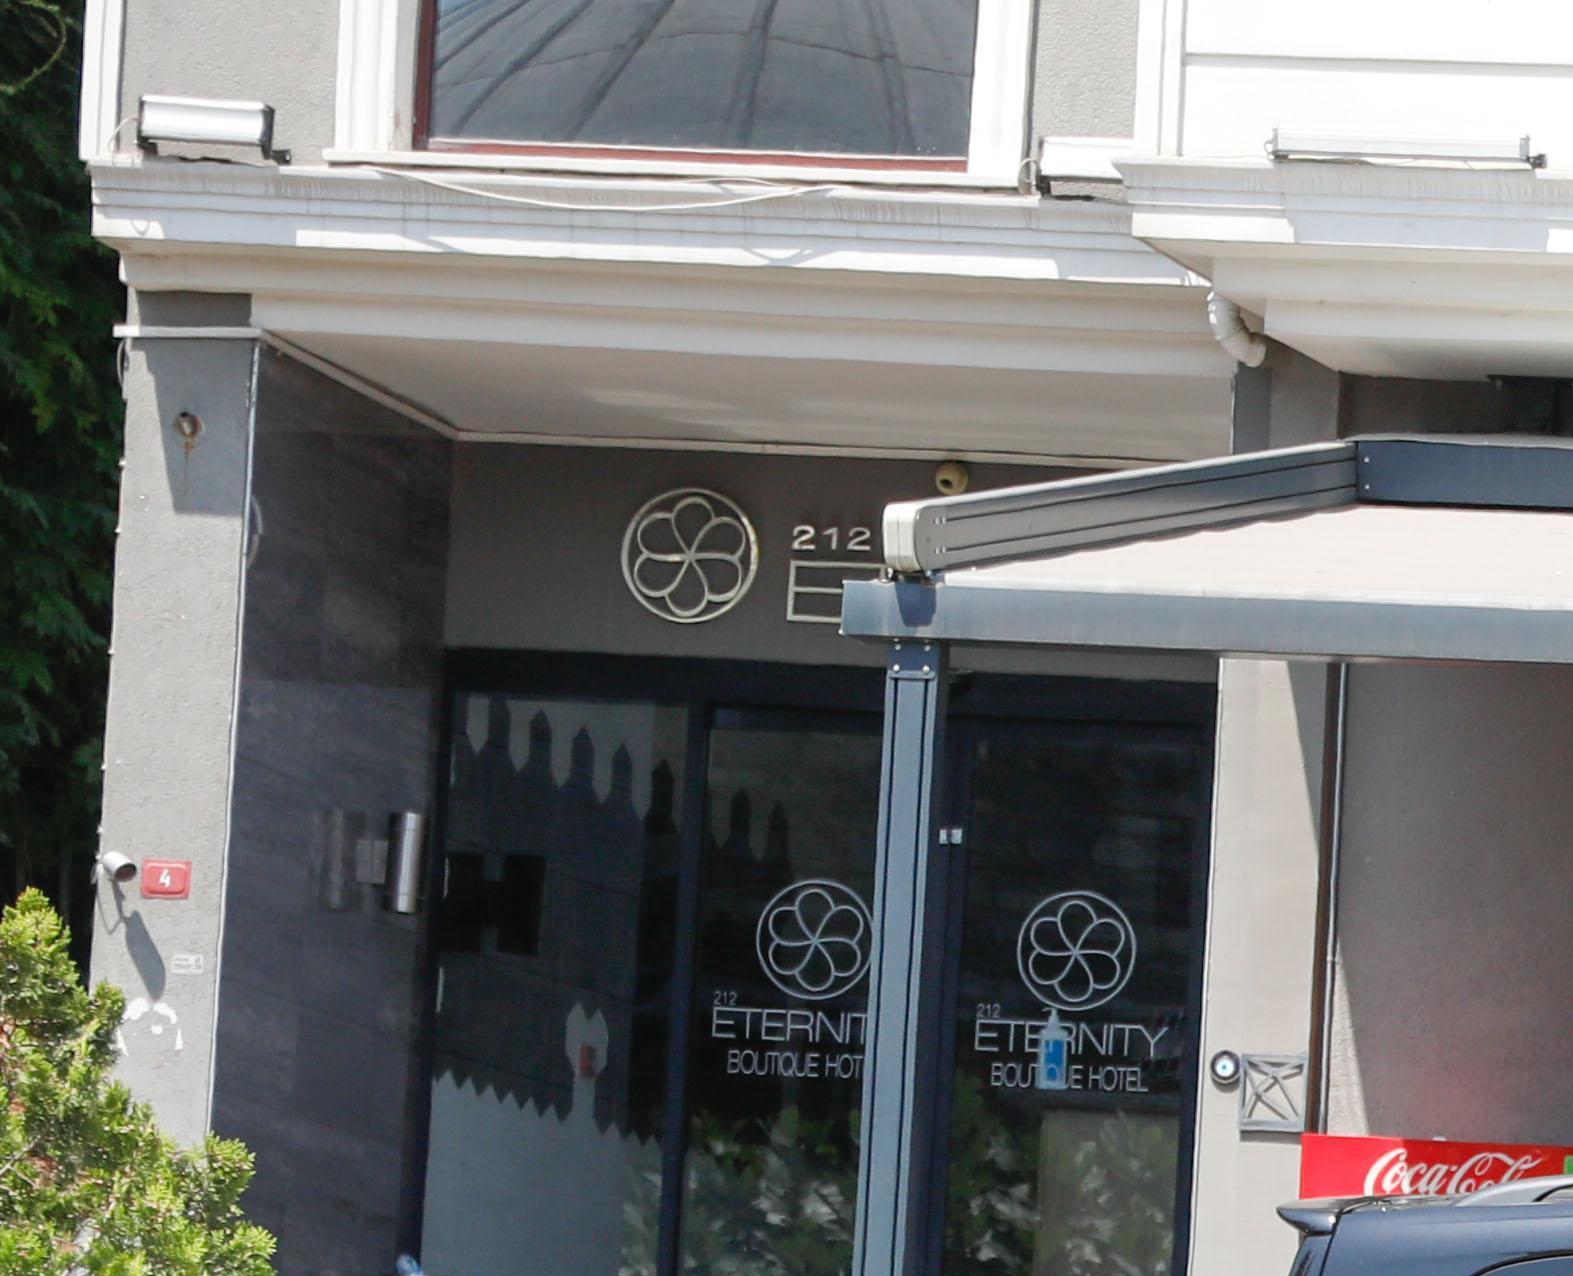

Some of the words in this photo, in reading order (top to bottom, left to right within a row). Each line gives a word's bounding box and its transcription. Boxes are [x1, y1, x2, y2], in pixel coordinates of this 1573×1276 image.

[792, 525, 871, 550] 212
[158, 869, 171, 888] 4
[712, 991, 737, 1006] 212
[976, 1003, 1000, 1018] 212
[712, 1006, 868, 1044] ETERNIT
[727, 1049, 820, 1078] BOUTIQUE
[825, 1053, 864, 1079] HOT
[1089, 1066, 1149, 1092] HOTEL
